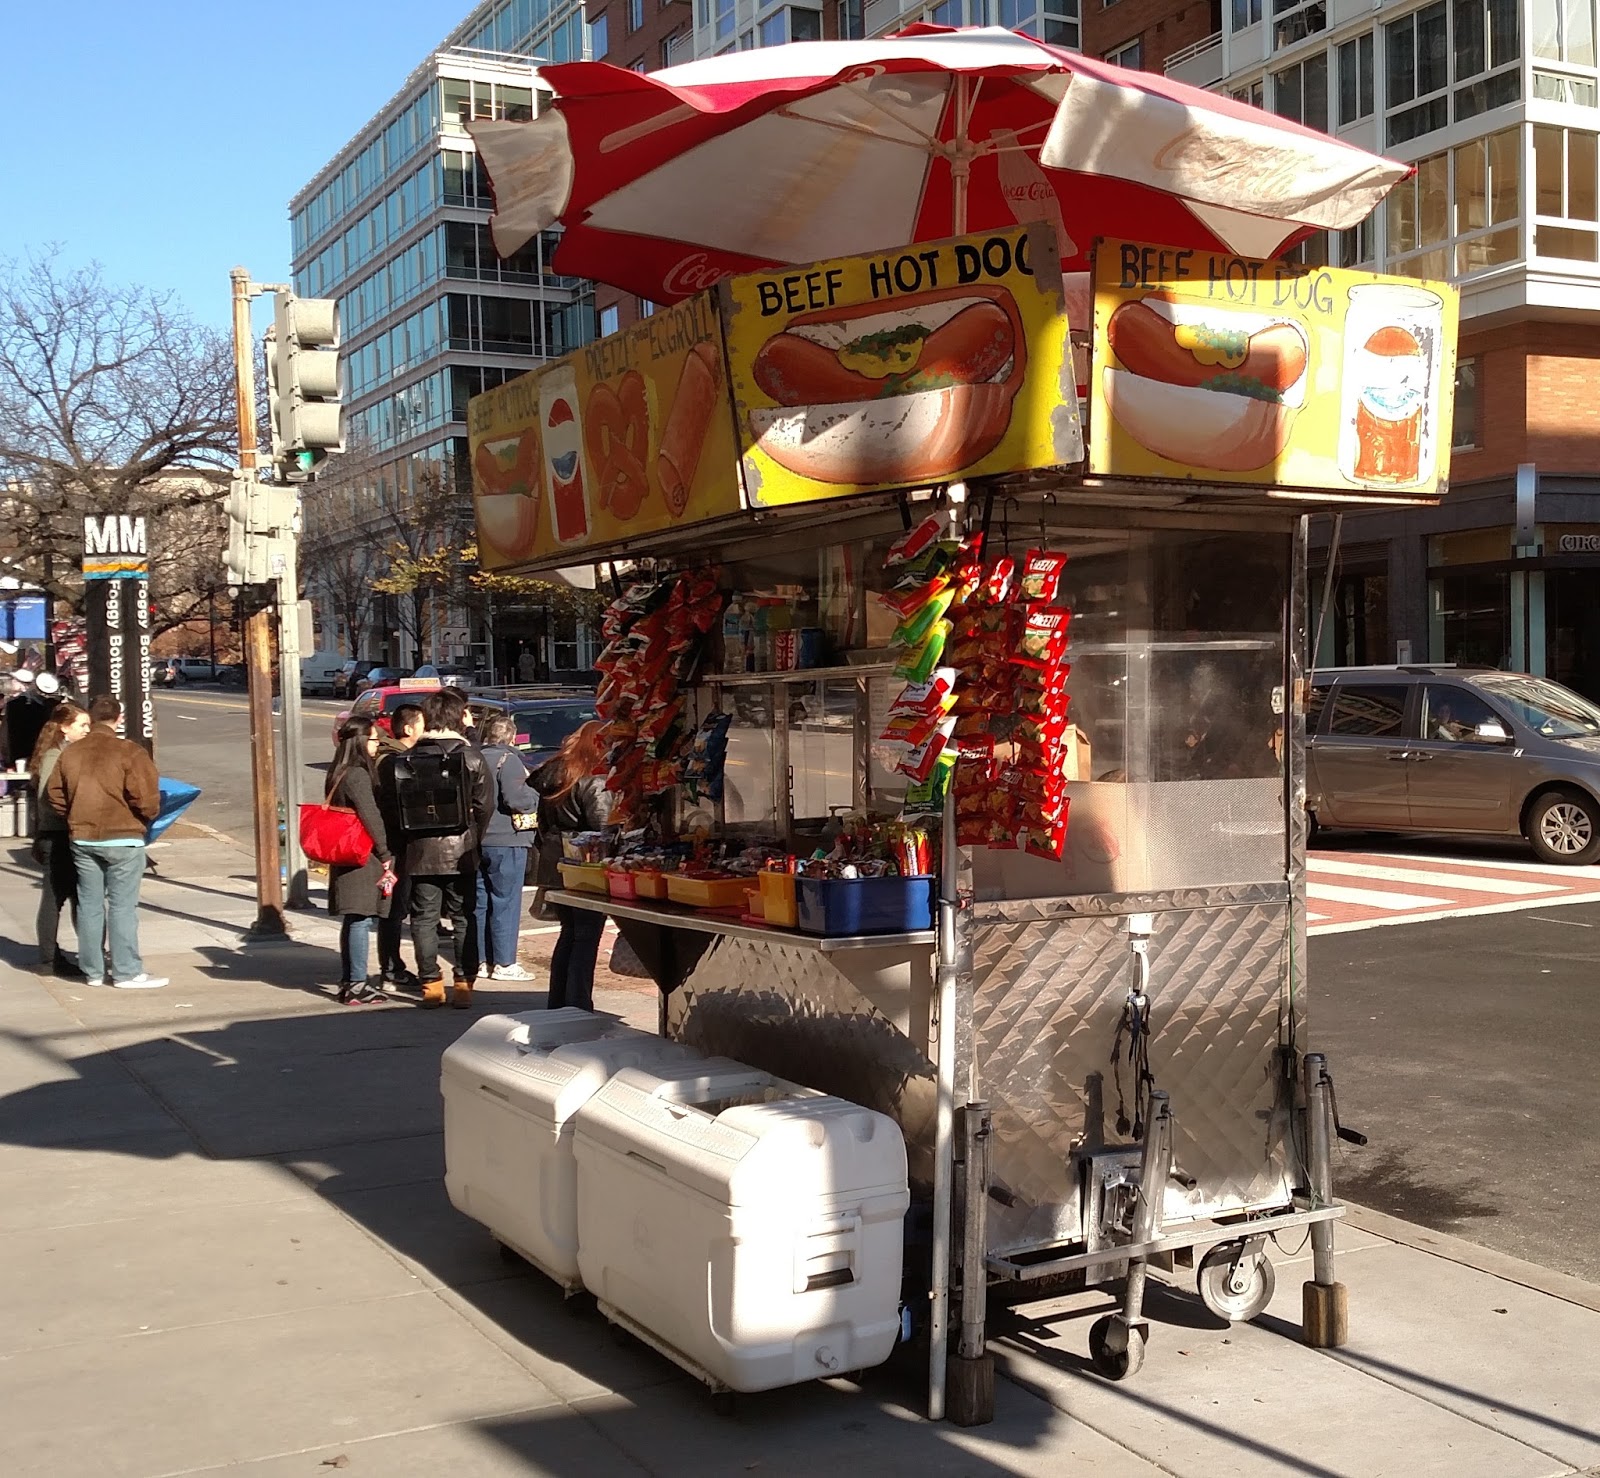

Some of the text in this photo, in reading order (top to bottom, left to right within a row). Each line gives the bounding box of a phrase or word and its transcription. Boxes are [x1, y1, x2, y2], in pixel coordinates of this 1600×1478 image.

[1003, 182, 1055, 201] oca-Cola
[663, 253, 732, 295] Coc
[757, 269, 843, 316] BEEF
[869, 250, 939, 298] HOT
[1119, 244, 1333, 315] BEEF HOT DOG
[106, 580, 121, 629] Foggy
[136, 580, 153, 738] Foggy Bottom-GWU
